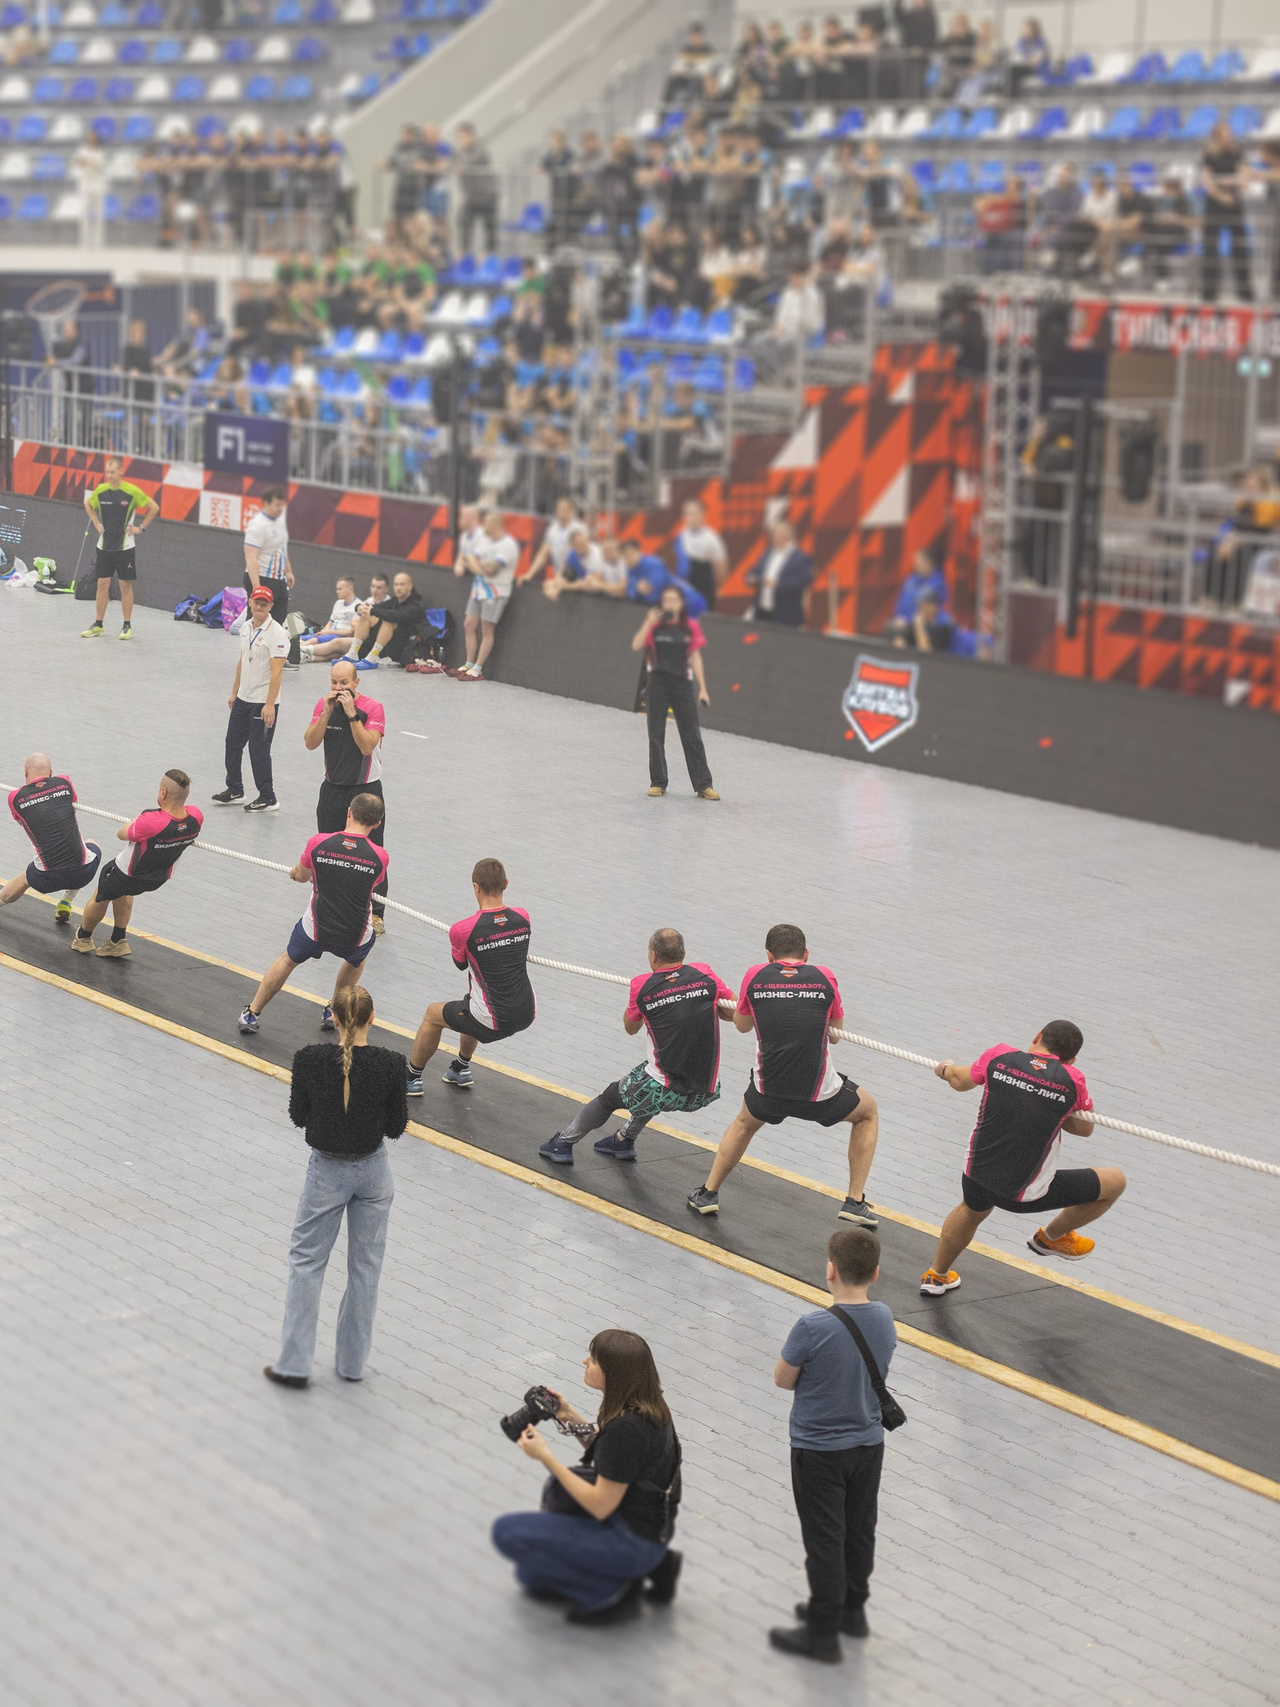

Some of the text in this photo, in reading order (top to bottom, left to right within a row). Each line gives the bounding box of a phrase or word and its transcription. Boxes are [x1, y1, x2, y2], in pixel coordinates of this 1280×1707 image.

[20, 790, 71, 809] БИЗНЕС-ЛИГА
[316, 856, 375, 874] БИЗНЕС-ЛИГА
[645, 988, 709, 1011] БИЗНЕС-ЛИГА
[753, 991, 826, 999] БИЗНЕС-ЛИГА
[992, 1070, 1066, 1103] БИЗНЕС-ЛИГА
[996, 1062, 1070, 1093] СК «ЩЕКИНОАЗОТ»
